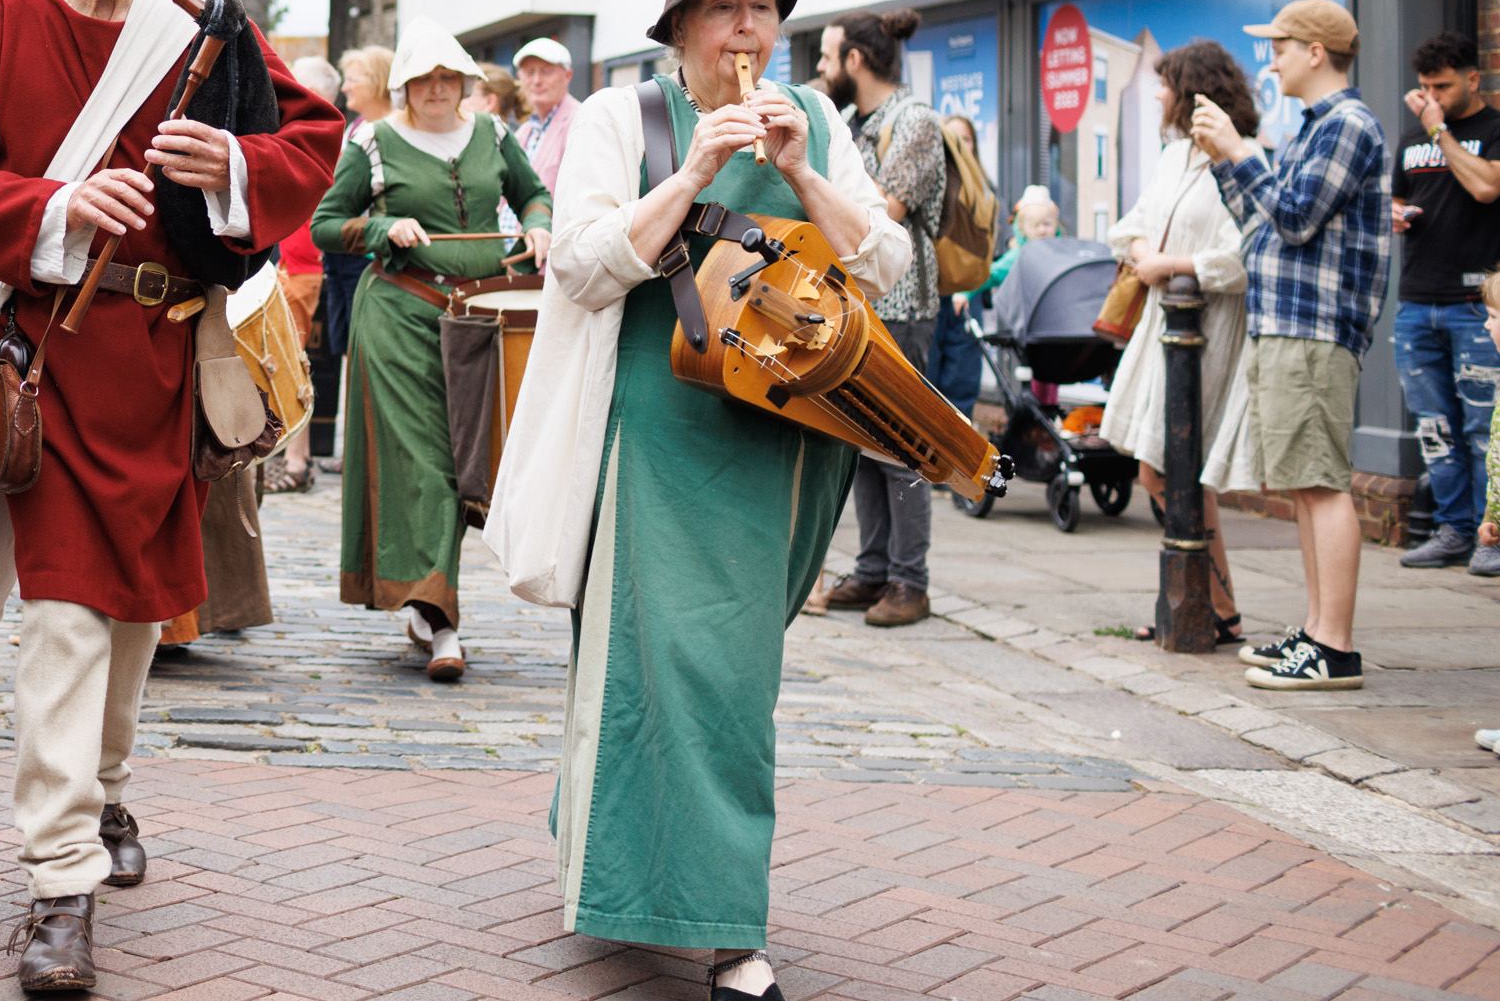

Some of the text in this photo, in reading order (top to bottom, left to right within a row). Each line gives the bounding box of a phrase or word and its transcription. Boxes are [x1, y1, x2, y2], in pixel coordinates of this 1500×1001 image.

[1054, 26, 1078, 46] NOW
[1046, 45, 1086, 69] LETTING
[941, 72, 983, 92] WESTGATE
[1045, 67, 1088, 89] SUMMER
[941, 88, 983, 130] ONE
[1403, 139, 1482, 172] HOODH
